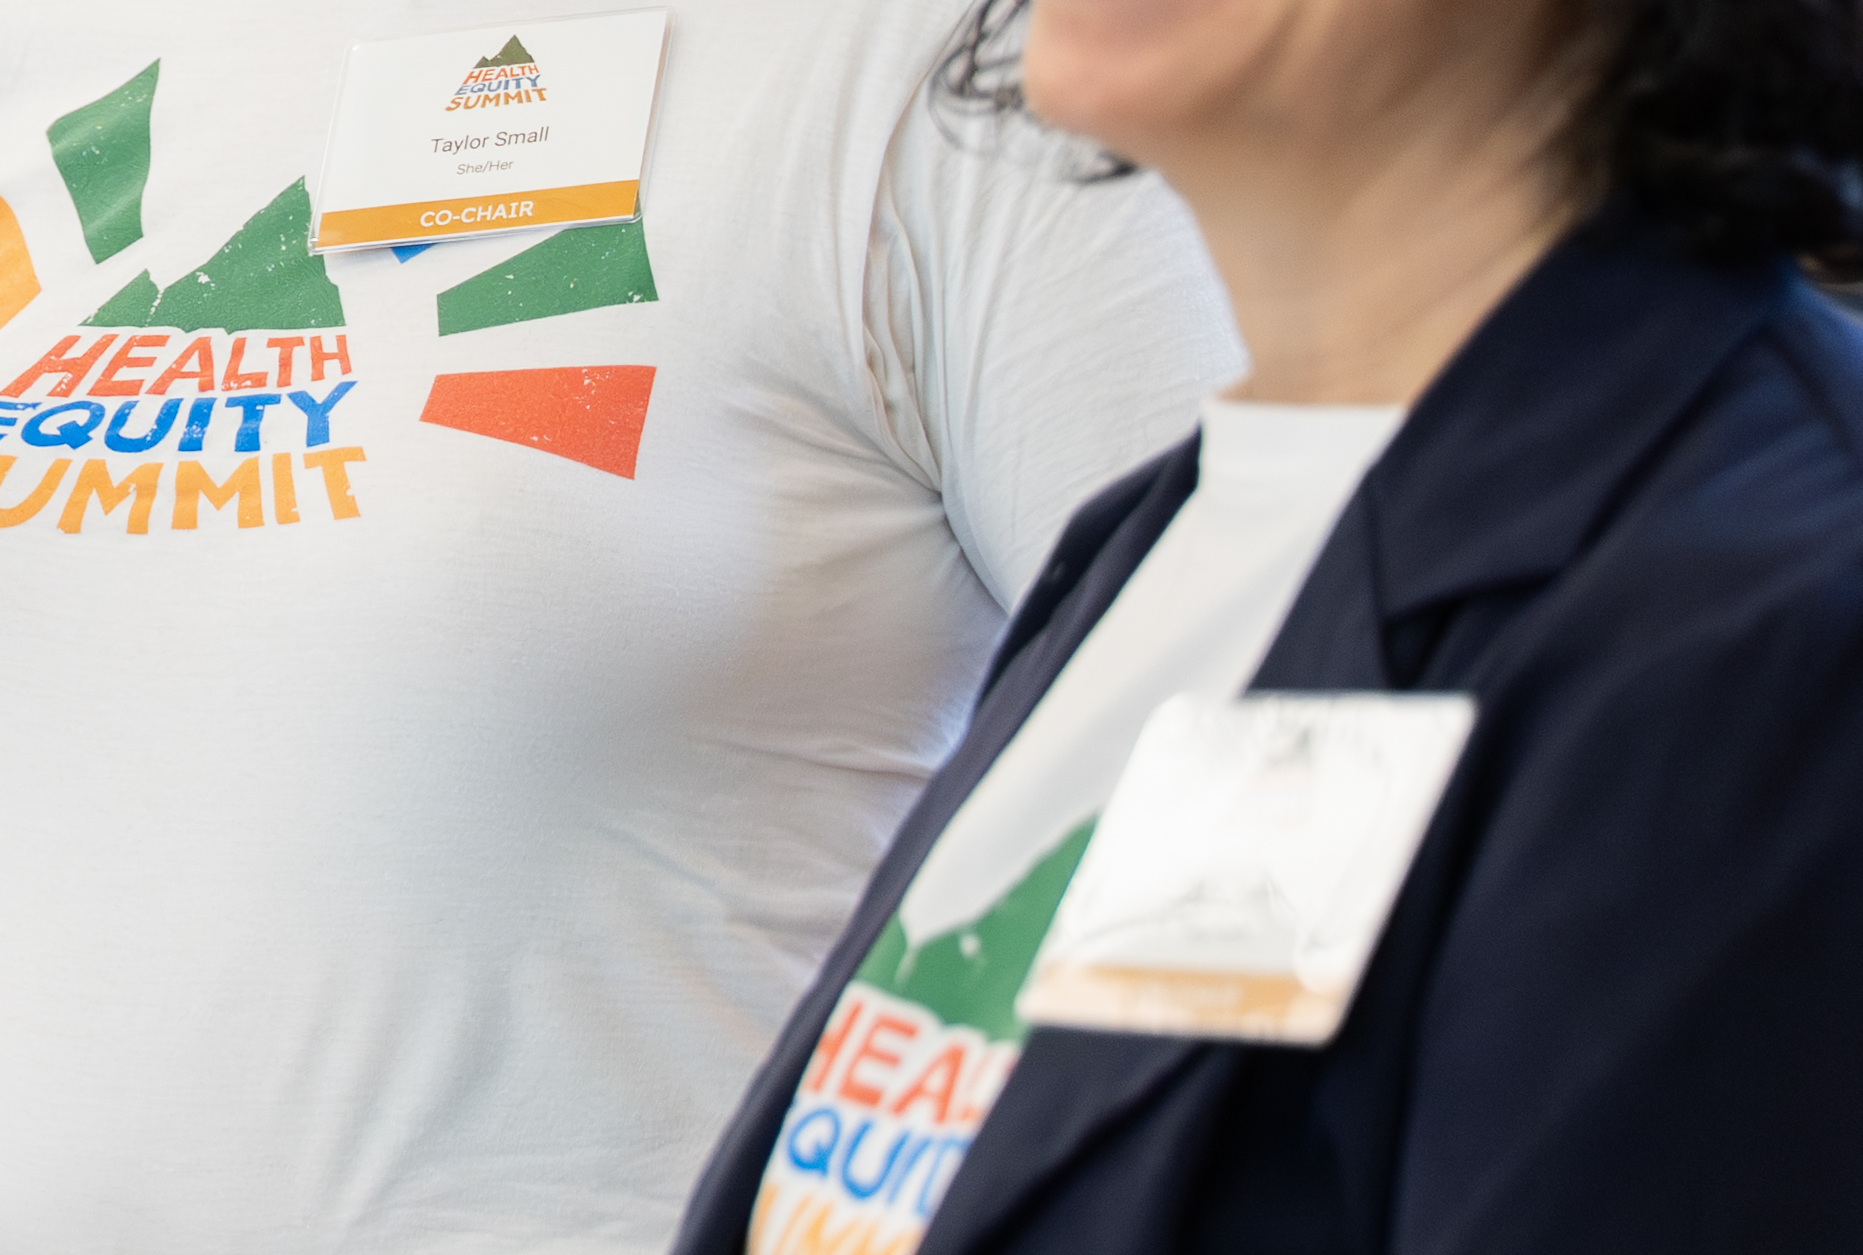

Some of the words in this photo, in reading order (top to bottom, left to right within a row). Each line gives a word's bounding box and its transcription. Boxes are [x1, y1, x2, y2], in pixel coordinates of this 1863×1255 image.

[454, 74, 541, 96] EQUITY
[461, 64, 540, 86] HEALTH
[444, 88, 547, 112] SUMMIT
[431, 135, 490, 155] Taylor
[494, 126, 550, 147] Small
[456, 160, 514, 175] She/Her
[420, 200, 535, 227] CO-CHAIR
[785, 1106, 971, 1219] QUIT
